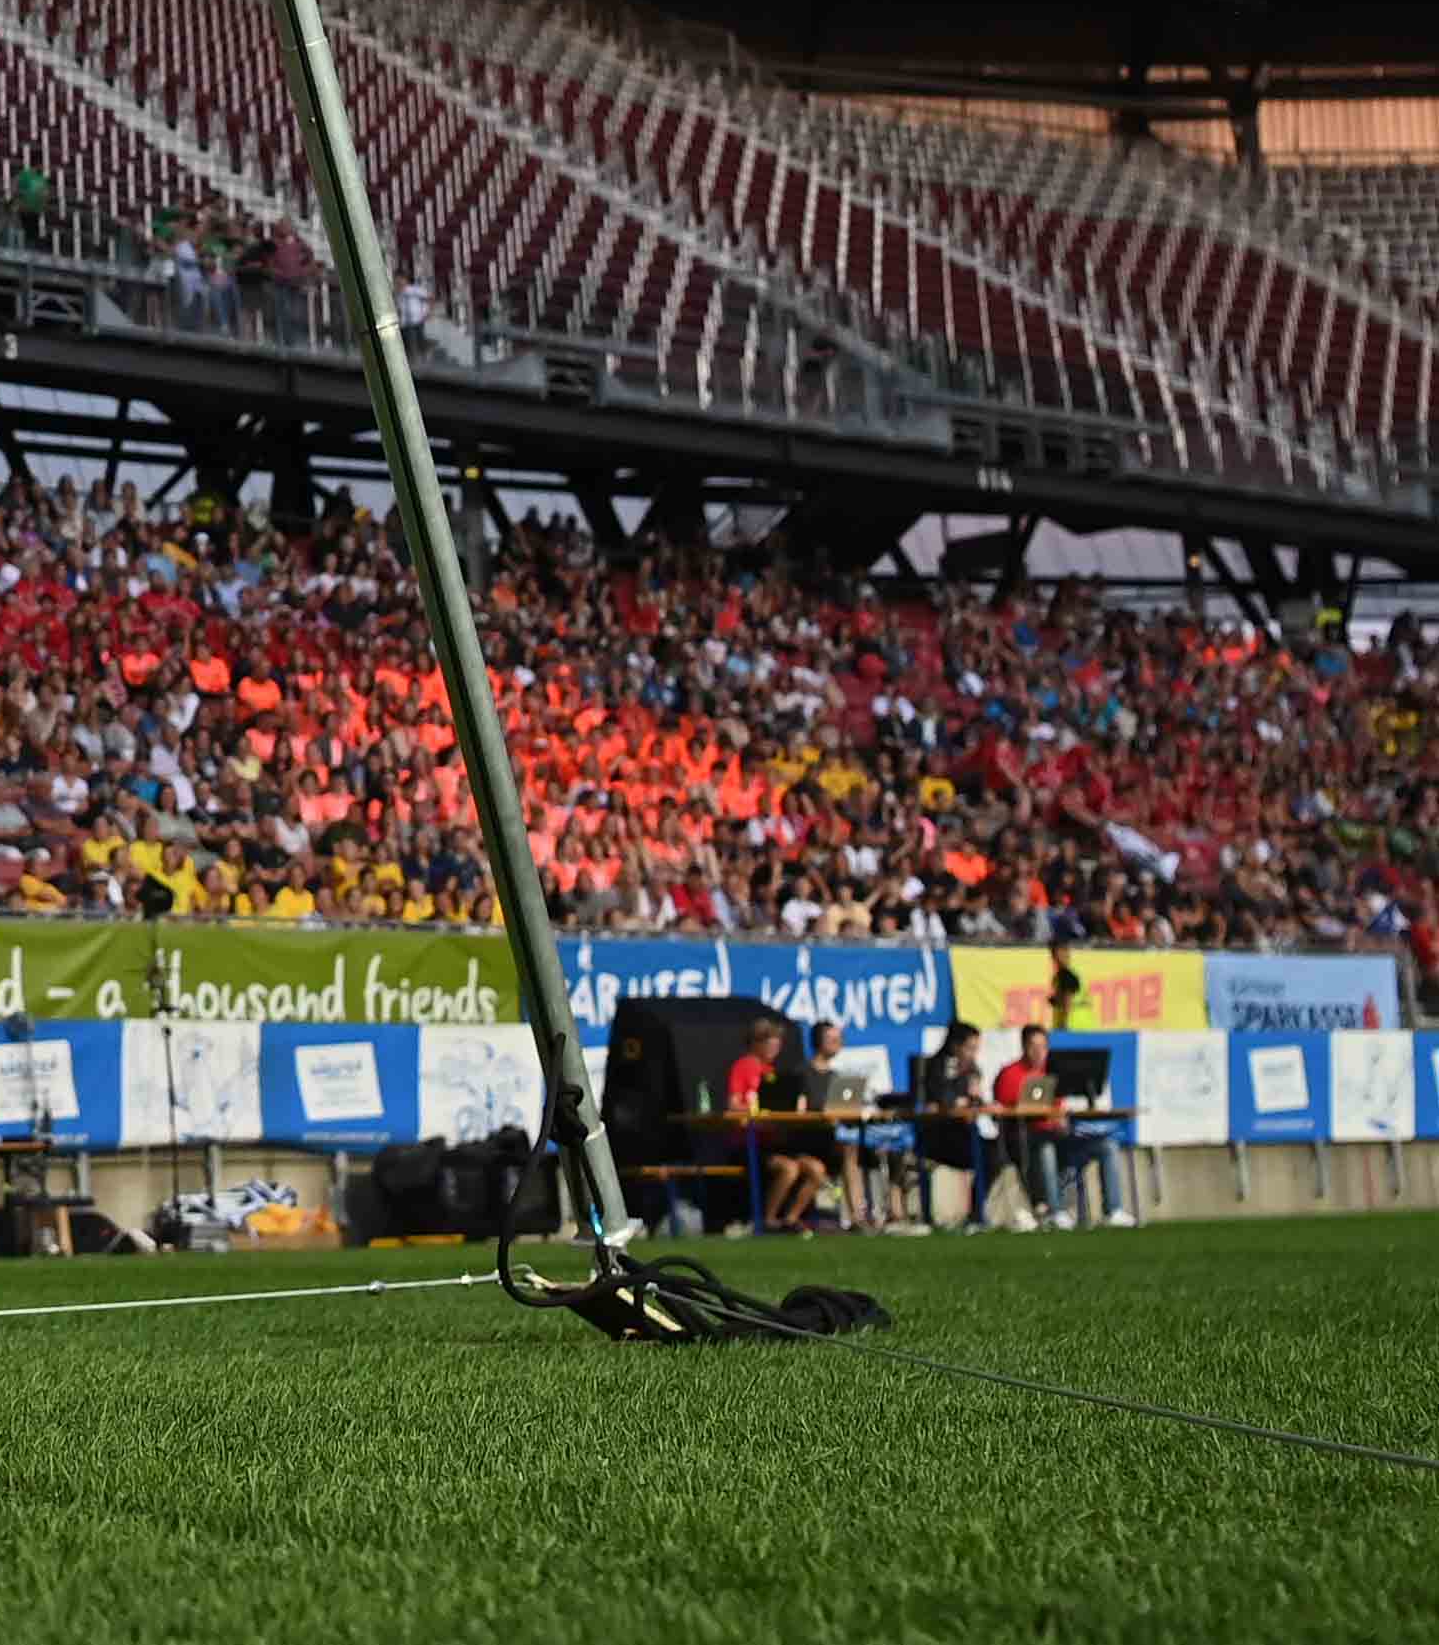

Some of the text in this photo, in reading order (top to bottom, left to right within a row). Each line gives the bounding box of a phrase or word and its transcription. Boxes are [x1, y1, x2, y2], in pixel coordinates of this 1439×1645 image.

[96, 979, 126, 1018] a
[365, 953, 500, 1023] friends
[565, 936, 732, 1027] ÄRNTEN
